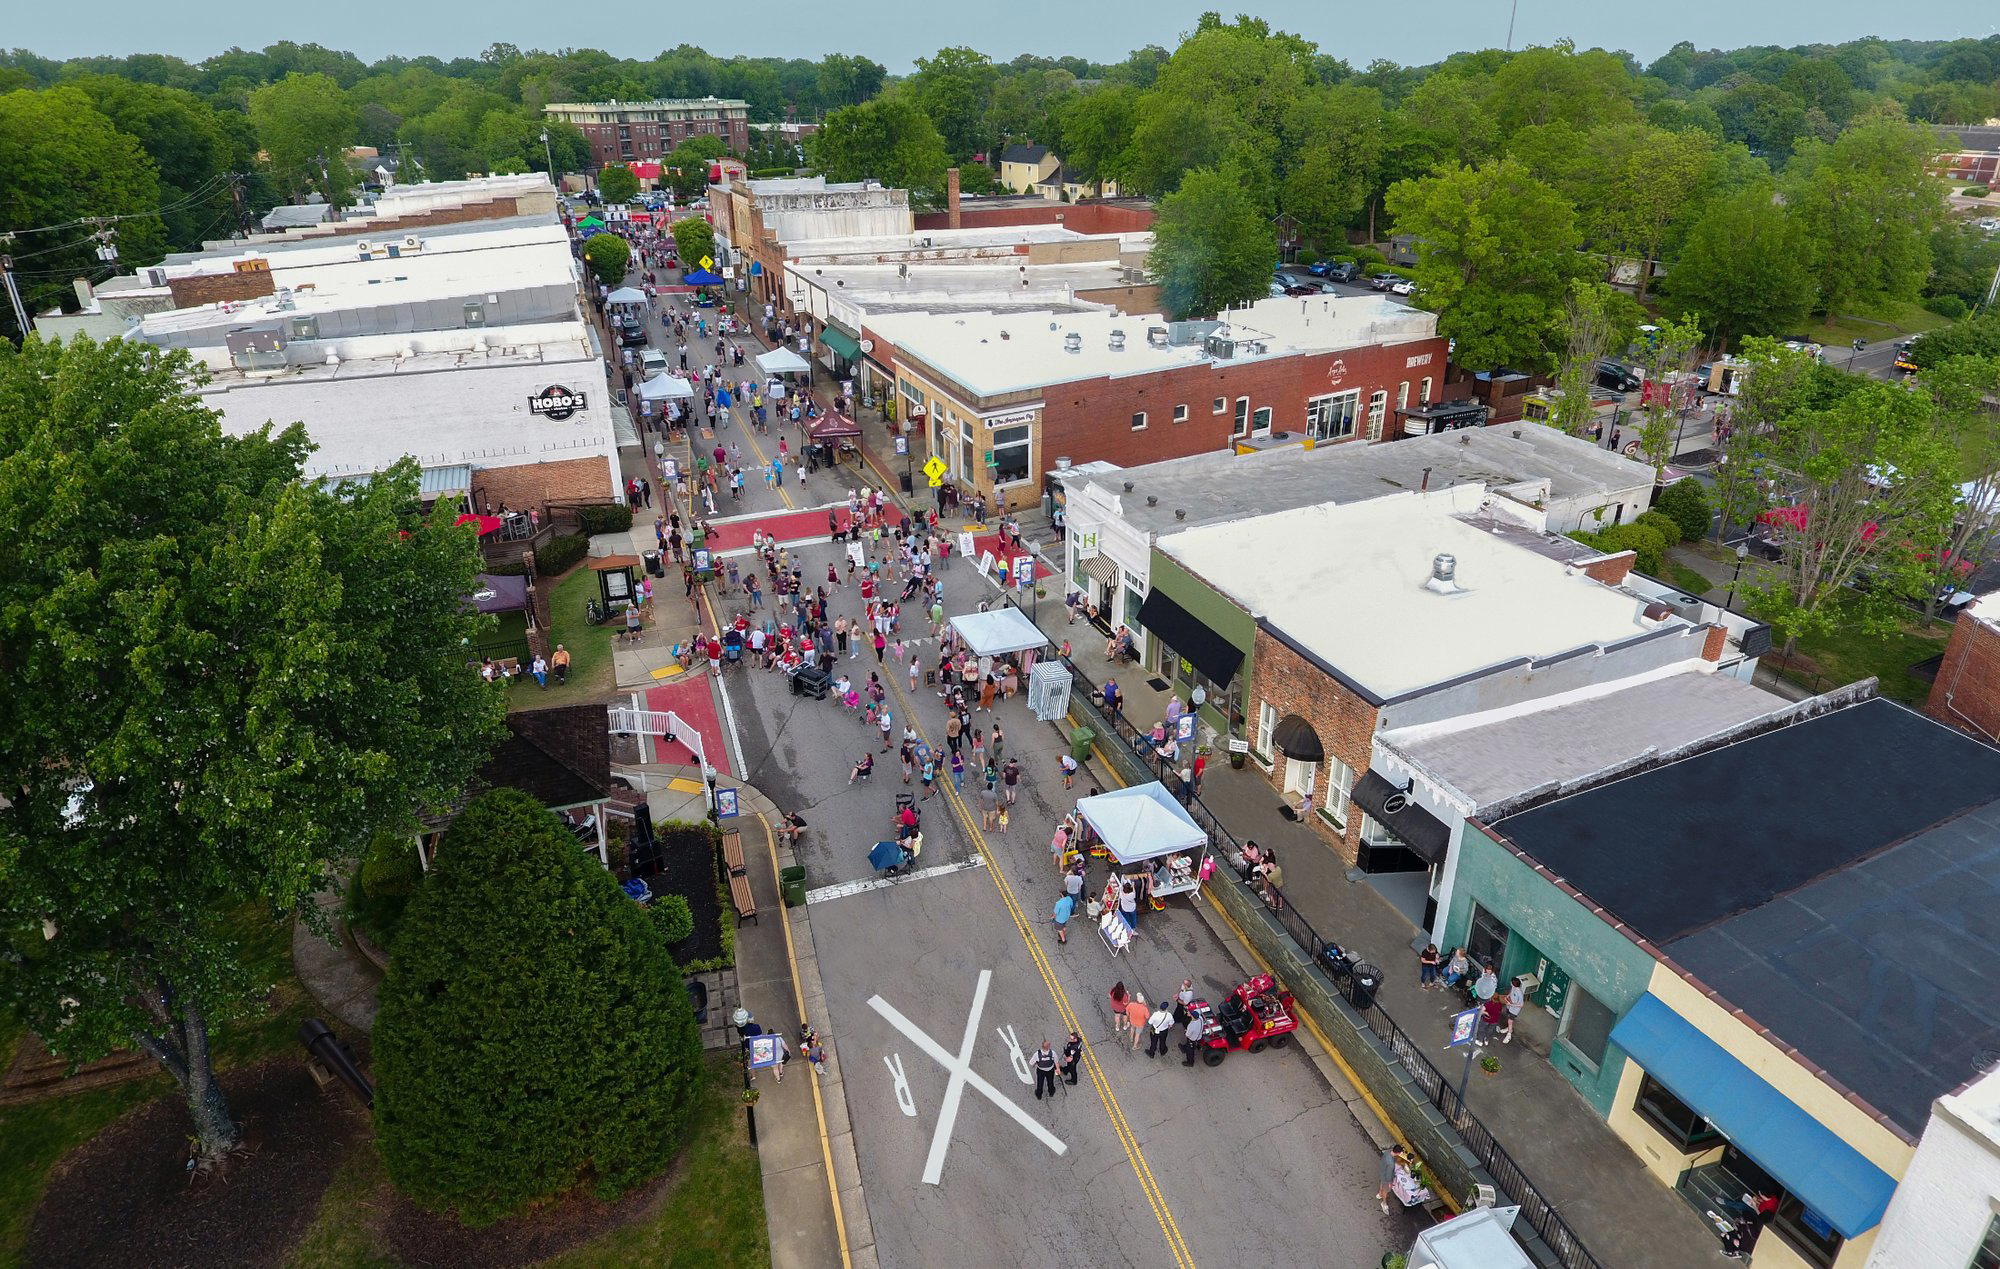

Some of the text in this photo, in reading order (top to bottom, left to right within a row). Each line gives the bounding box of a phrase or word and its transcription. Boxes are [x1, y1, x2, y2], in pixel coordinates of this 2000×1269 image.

[1406, 353, 1433, 368] BREWERY
[532, 396, 583, 409] HOBO'S
[1083, 532, 1096, 549] H
